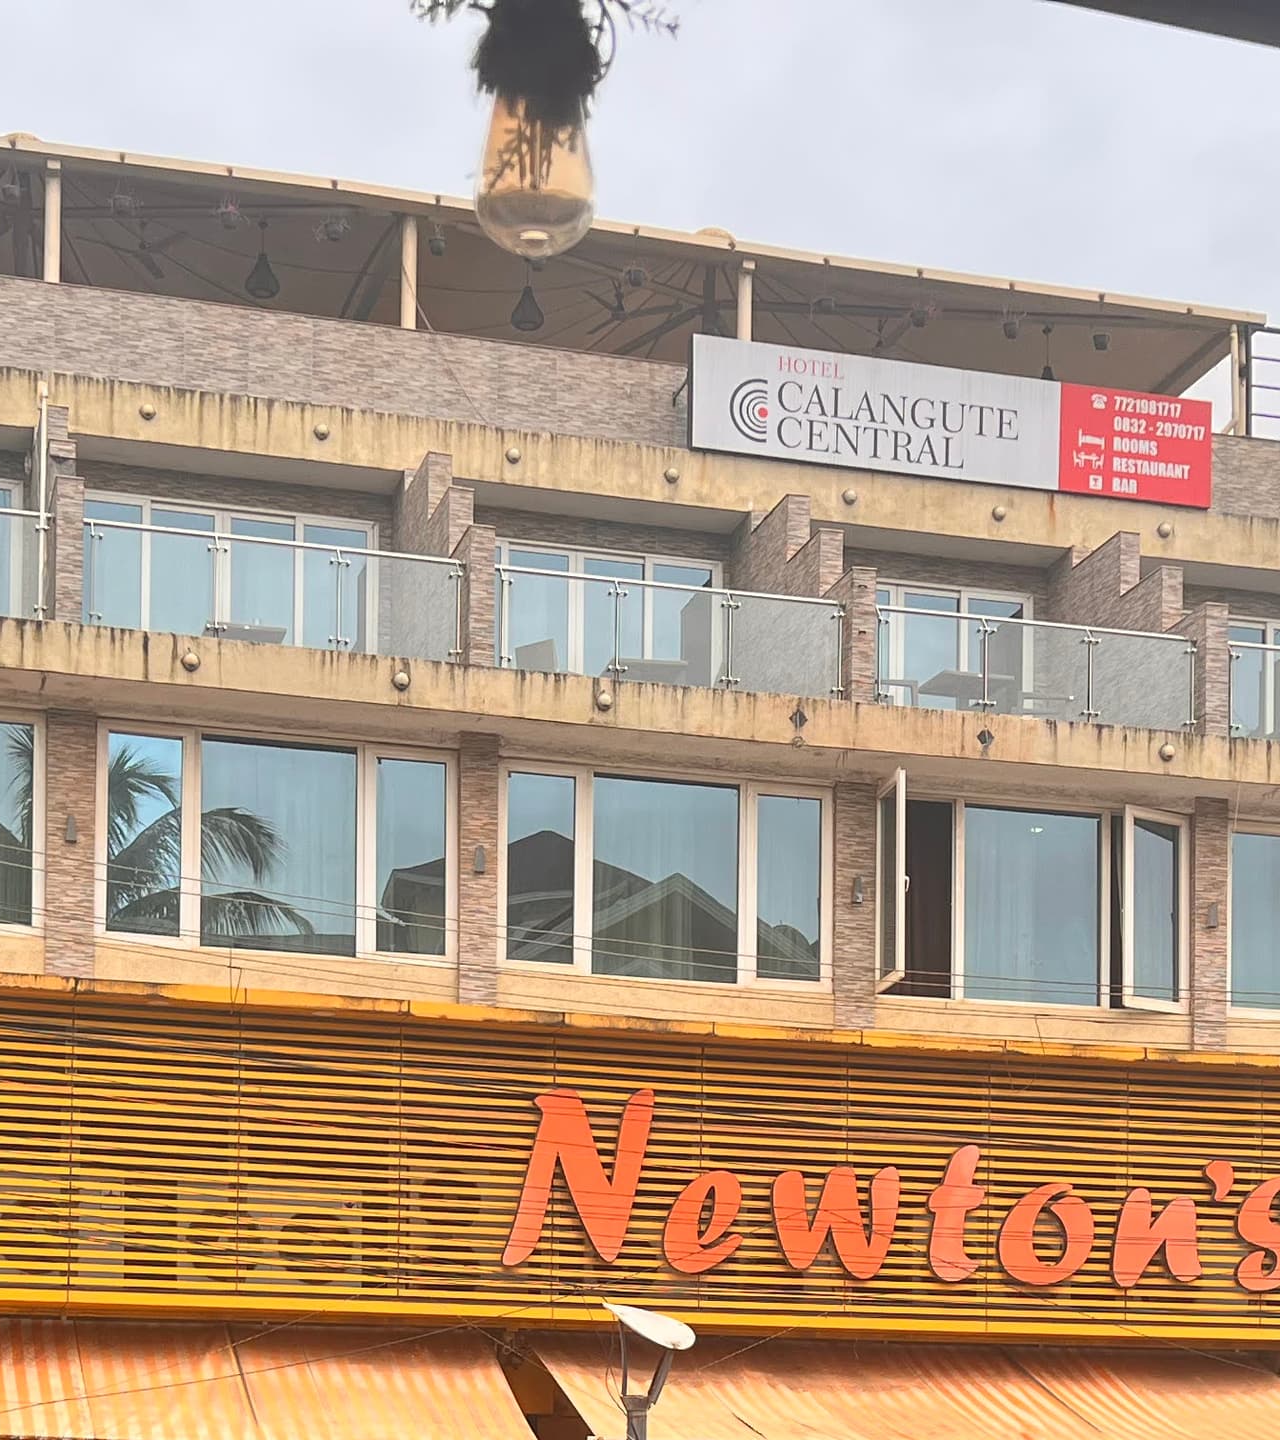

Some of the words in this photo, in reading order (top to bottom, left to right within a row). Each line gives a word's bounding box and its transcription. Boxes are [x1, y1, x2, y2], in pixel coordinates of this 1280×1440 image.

[778, 356, 845, 379] HOTEL
[777, 381, 1019, 441] CALANGUTE
[1114, 396, 1181, 418] 7721981717
[1114, 416, 1146, 434] 0832
[1156, 422, 1205, 440] 2970717
[776, 416, 965, 470] CENTRAL
[1112, 437, 1158, 456] ROOMS
[1112, 457, 1190, 480] RESTAURANT
[1112, 477, 1137, 494] BAR
